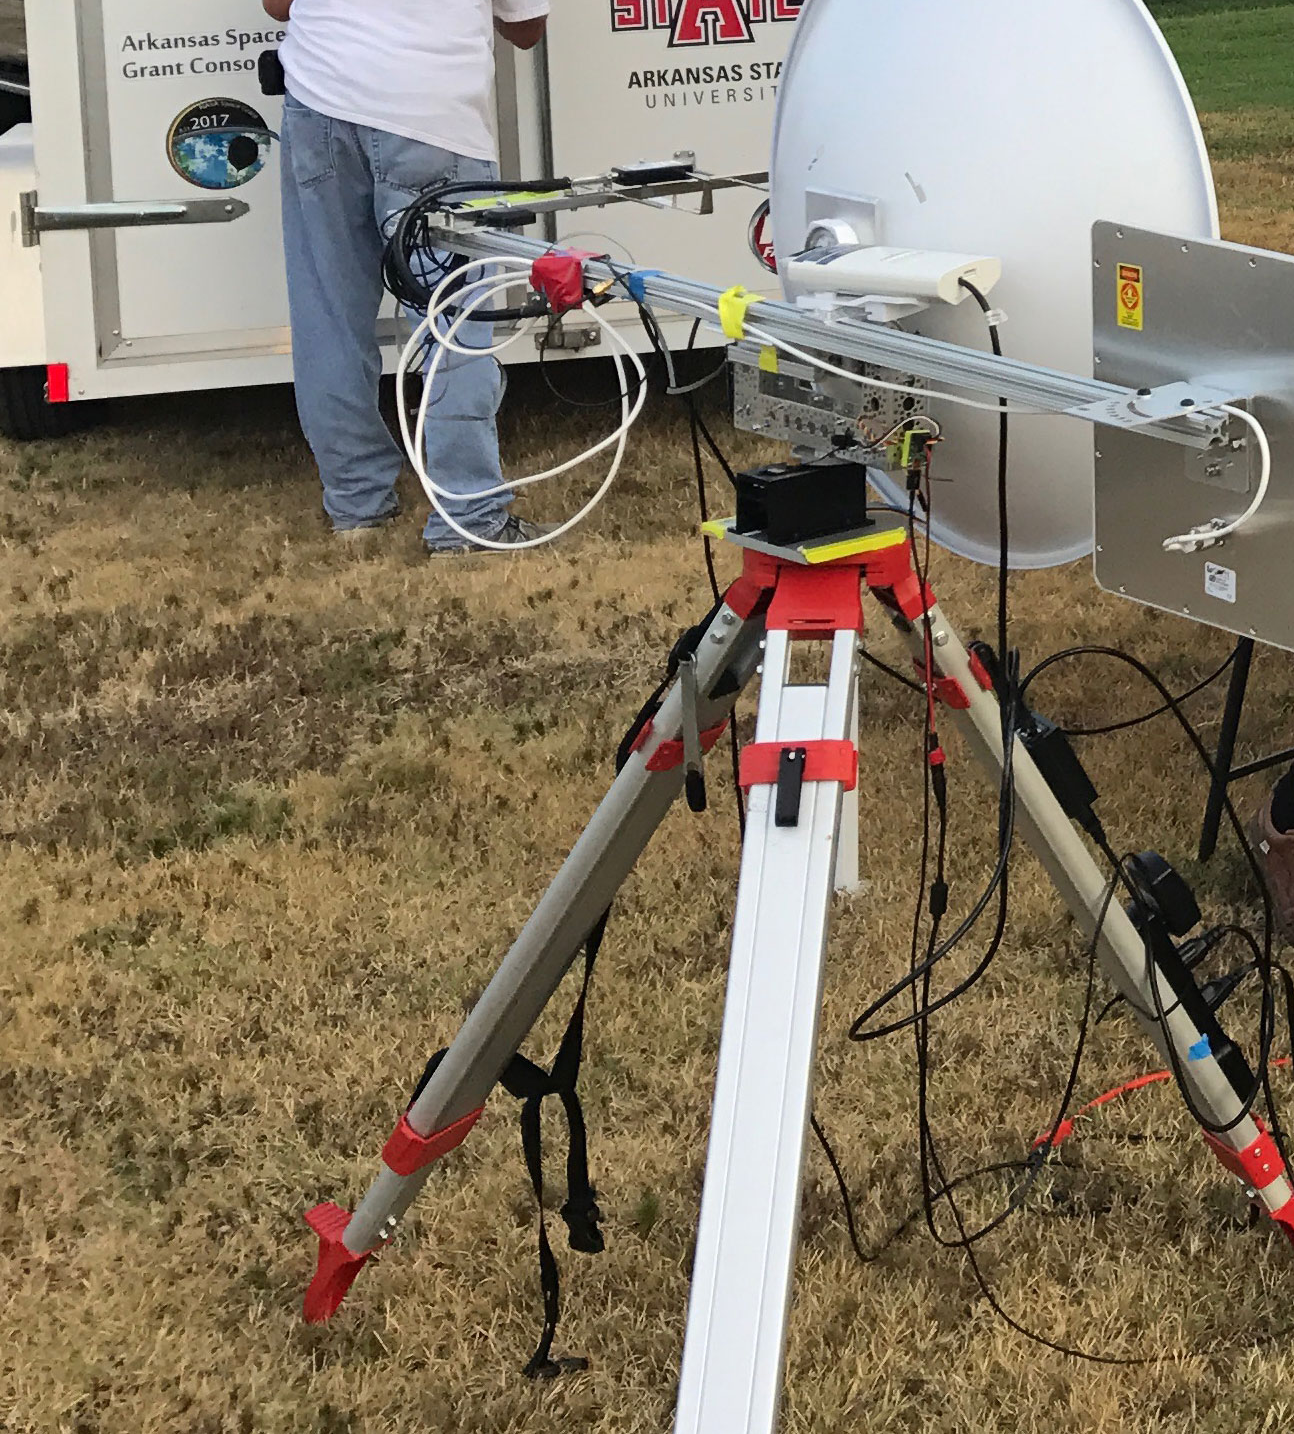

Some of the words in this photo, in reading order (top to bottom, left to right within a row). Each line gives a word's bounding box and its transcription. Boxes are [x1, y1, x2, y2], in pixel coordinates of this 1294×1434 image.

[122, 32, 220, 52] Arkansas
[225, 28, 287, 51] Space
[122, 61, 184, 79] Grant
[190, 57, 256, 74] Conso
[627, 65, 743, 90] ARKANSAS
[190, 114, 230, 130] 2017
